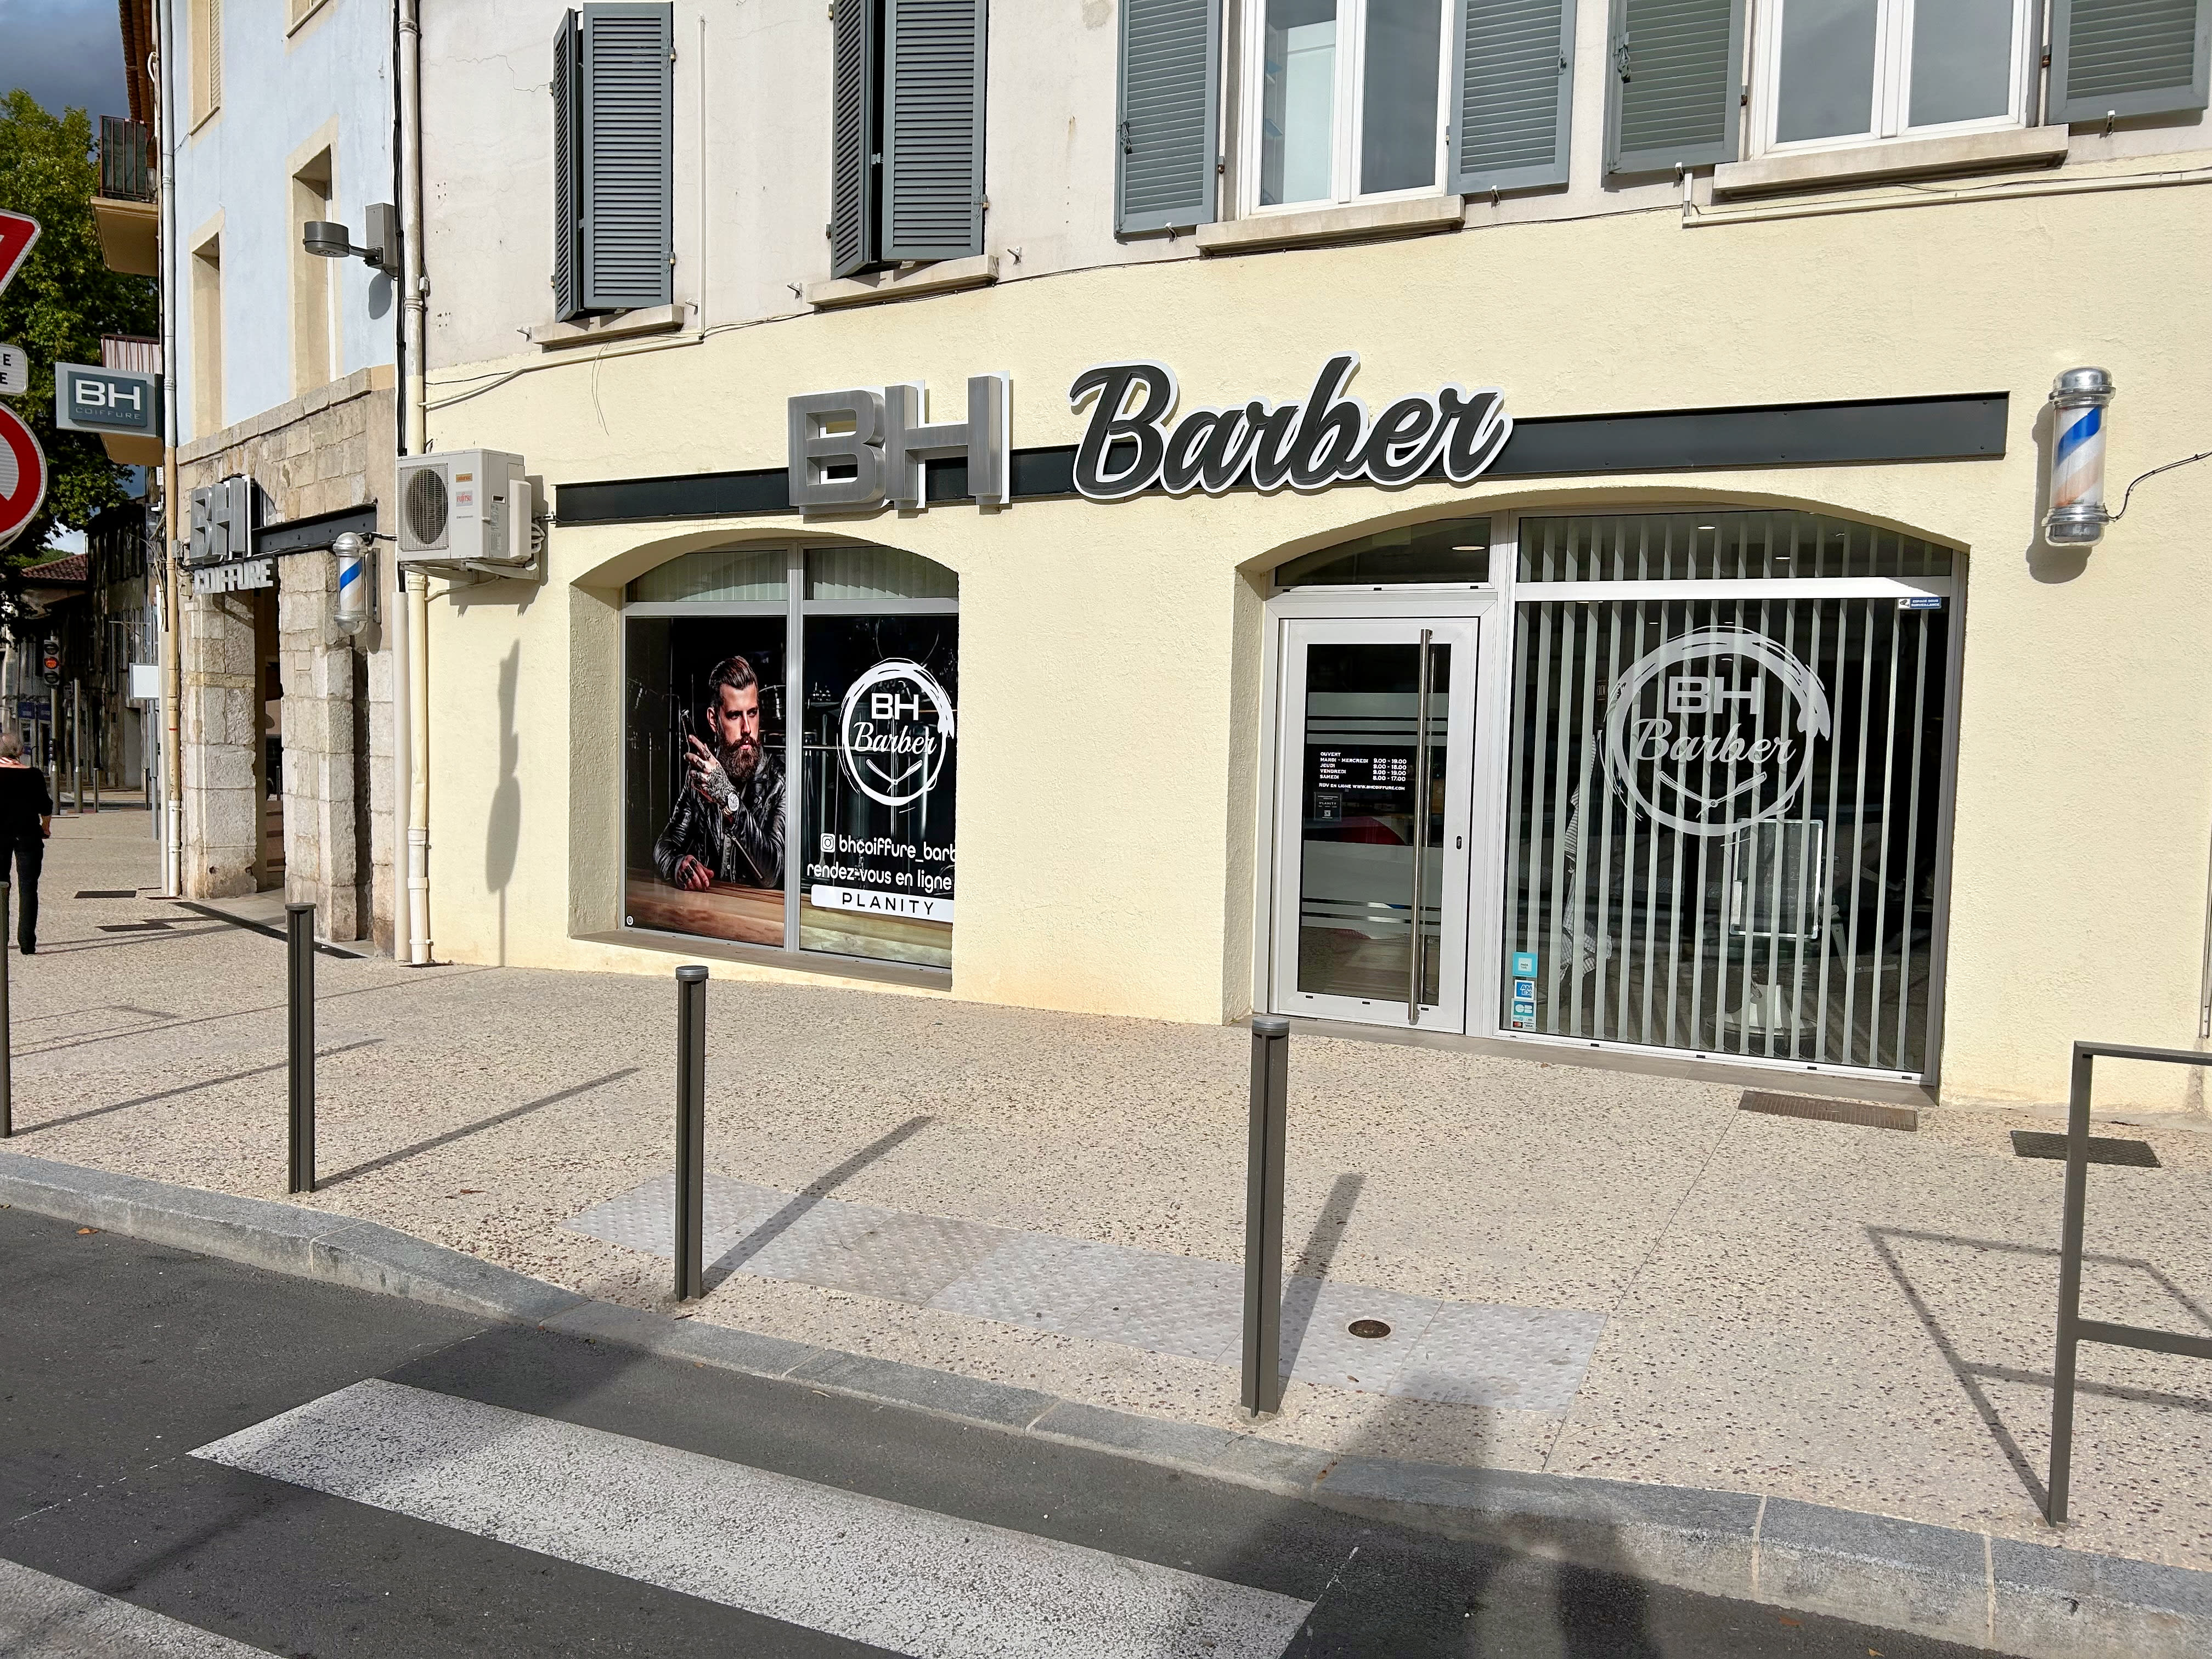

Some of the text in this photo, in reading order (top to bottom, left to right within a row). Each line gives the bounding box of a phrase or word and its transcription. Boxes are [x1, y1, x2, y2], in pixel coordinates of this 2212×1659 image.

[75, 379, 140, 410] BH
[76, 407, 140, 420] COIFFURE
[788, 351, 1515, 514] BH Barber
[456, 492, 472, 504] FUJITSU
[190, 475, 251, 564] BH
[194, 558, 273, 594] COIFFURE
[871, 693, 919, 721] BH
[1668, 676, 1762, 714] BH
[853, 721, 937, 755] Barber
[1633, 719, 1797, 765] Barber
[807, 862, 952, 893] rendez-vous en ligne
[843, 893, 934, 915] PLANITY
